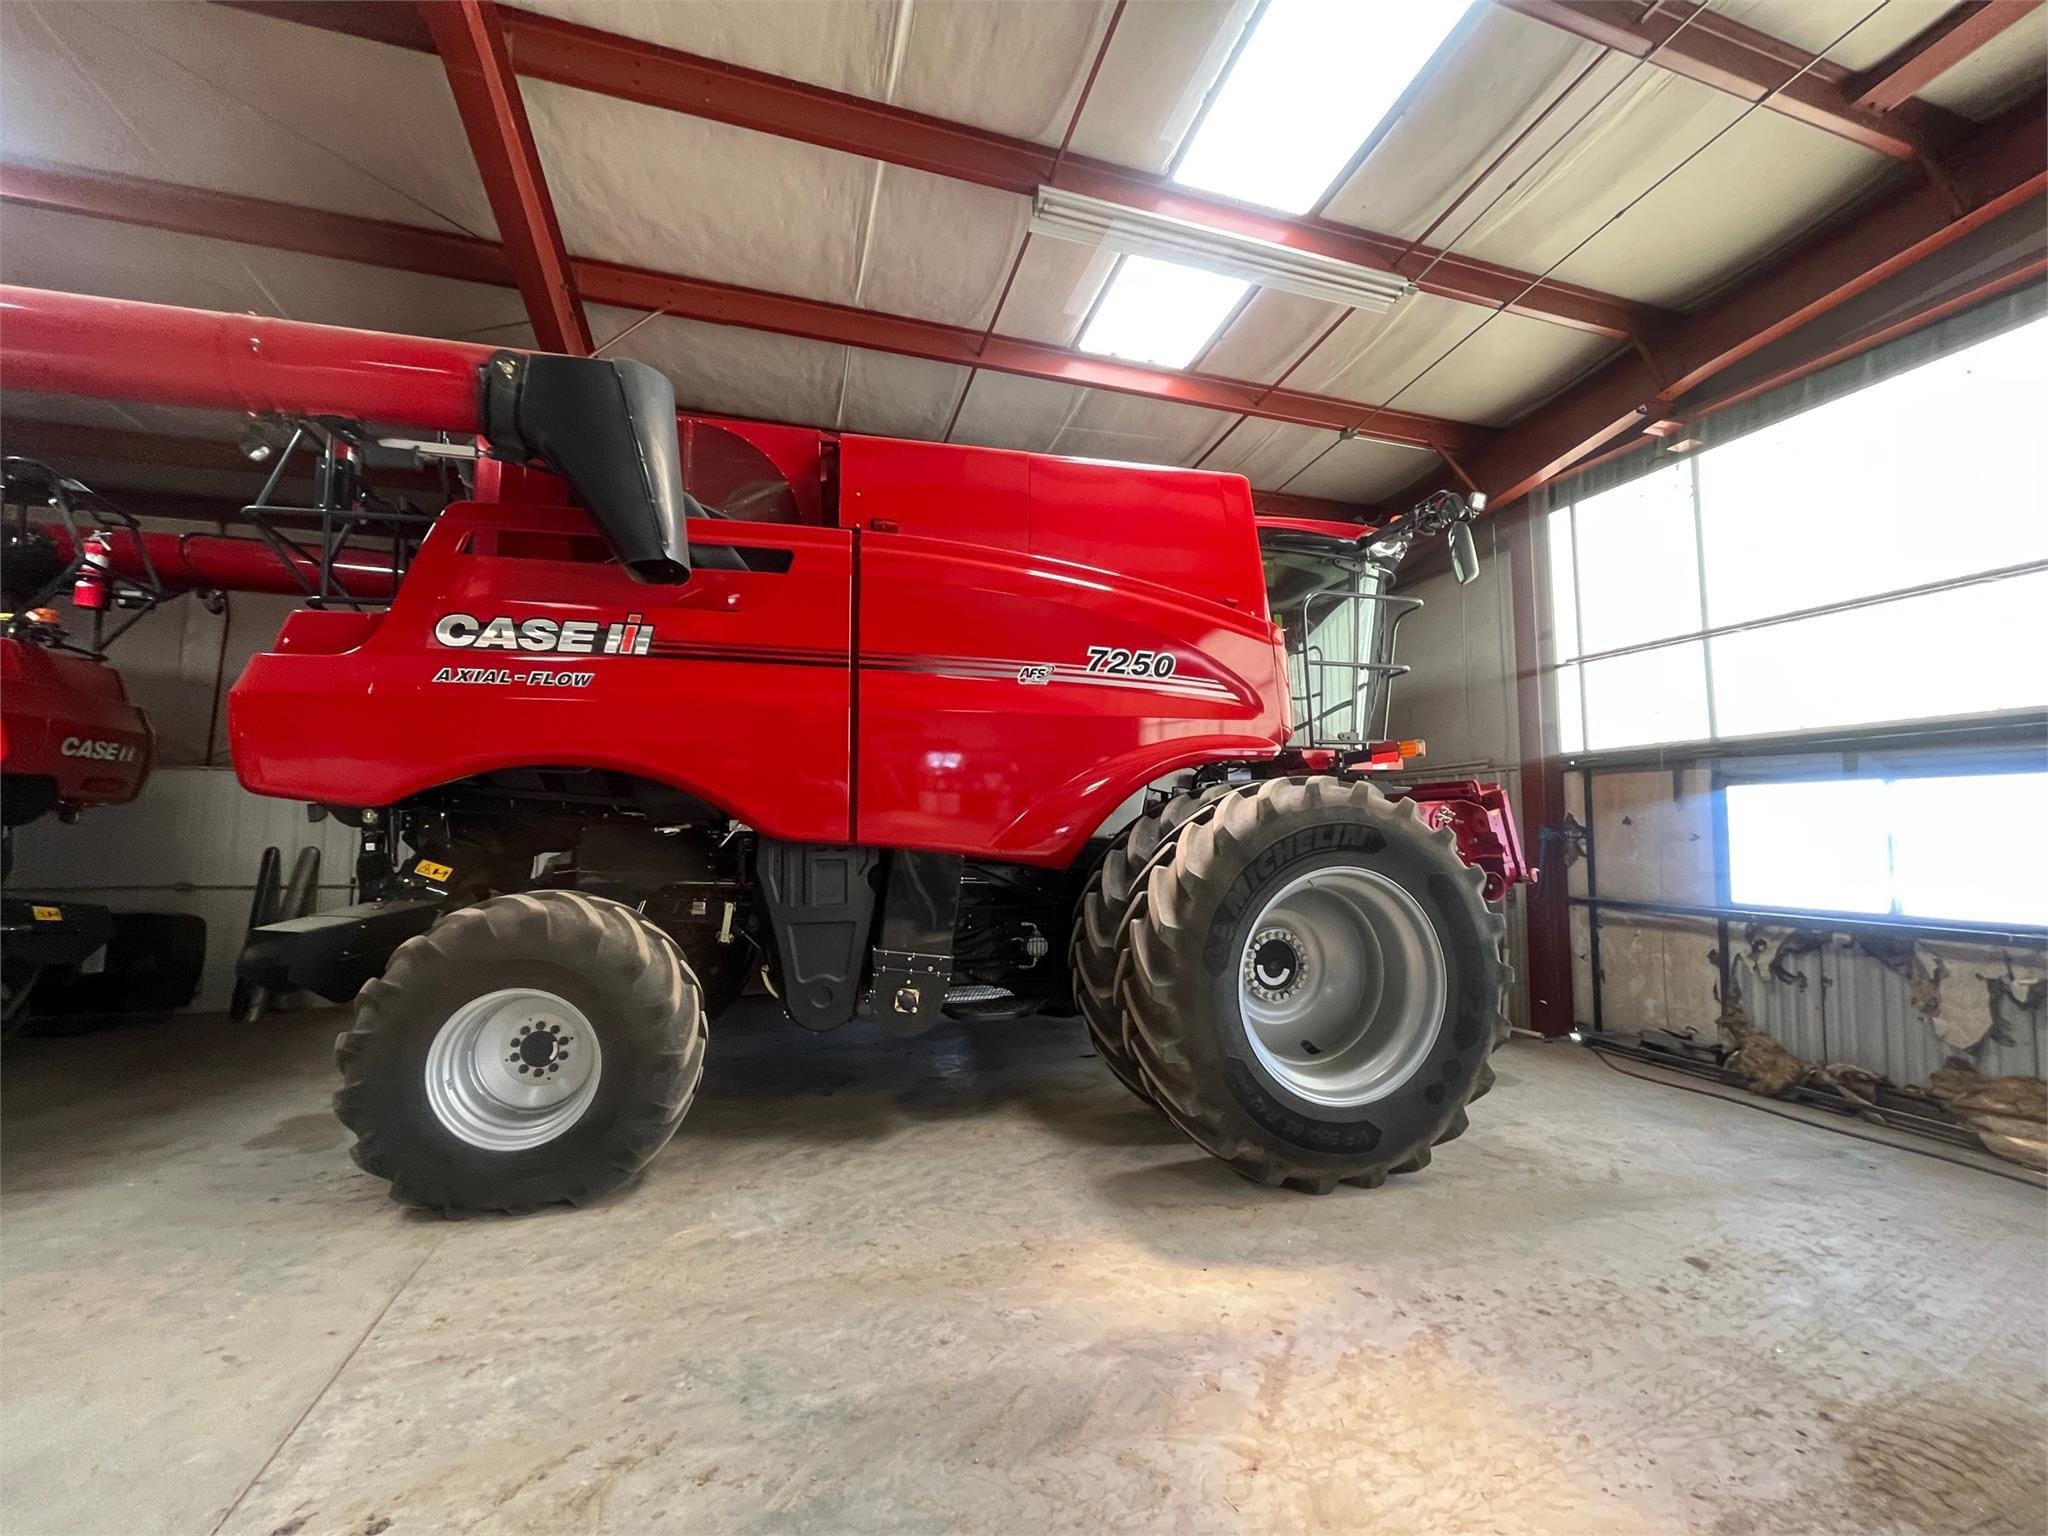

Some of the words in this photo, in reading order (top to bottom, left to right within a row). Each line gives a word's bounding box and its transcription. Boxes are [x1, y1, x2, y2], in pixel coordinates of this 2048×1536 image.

[435, 614, 598, 652] CASE
[1018, 666, 1048, 680] AFS
[1087, 646, 1177, 678] 7250
[61, 737, 118, 760] CASE
[1226, 825, 1369, 918] MICHELIN
